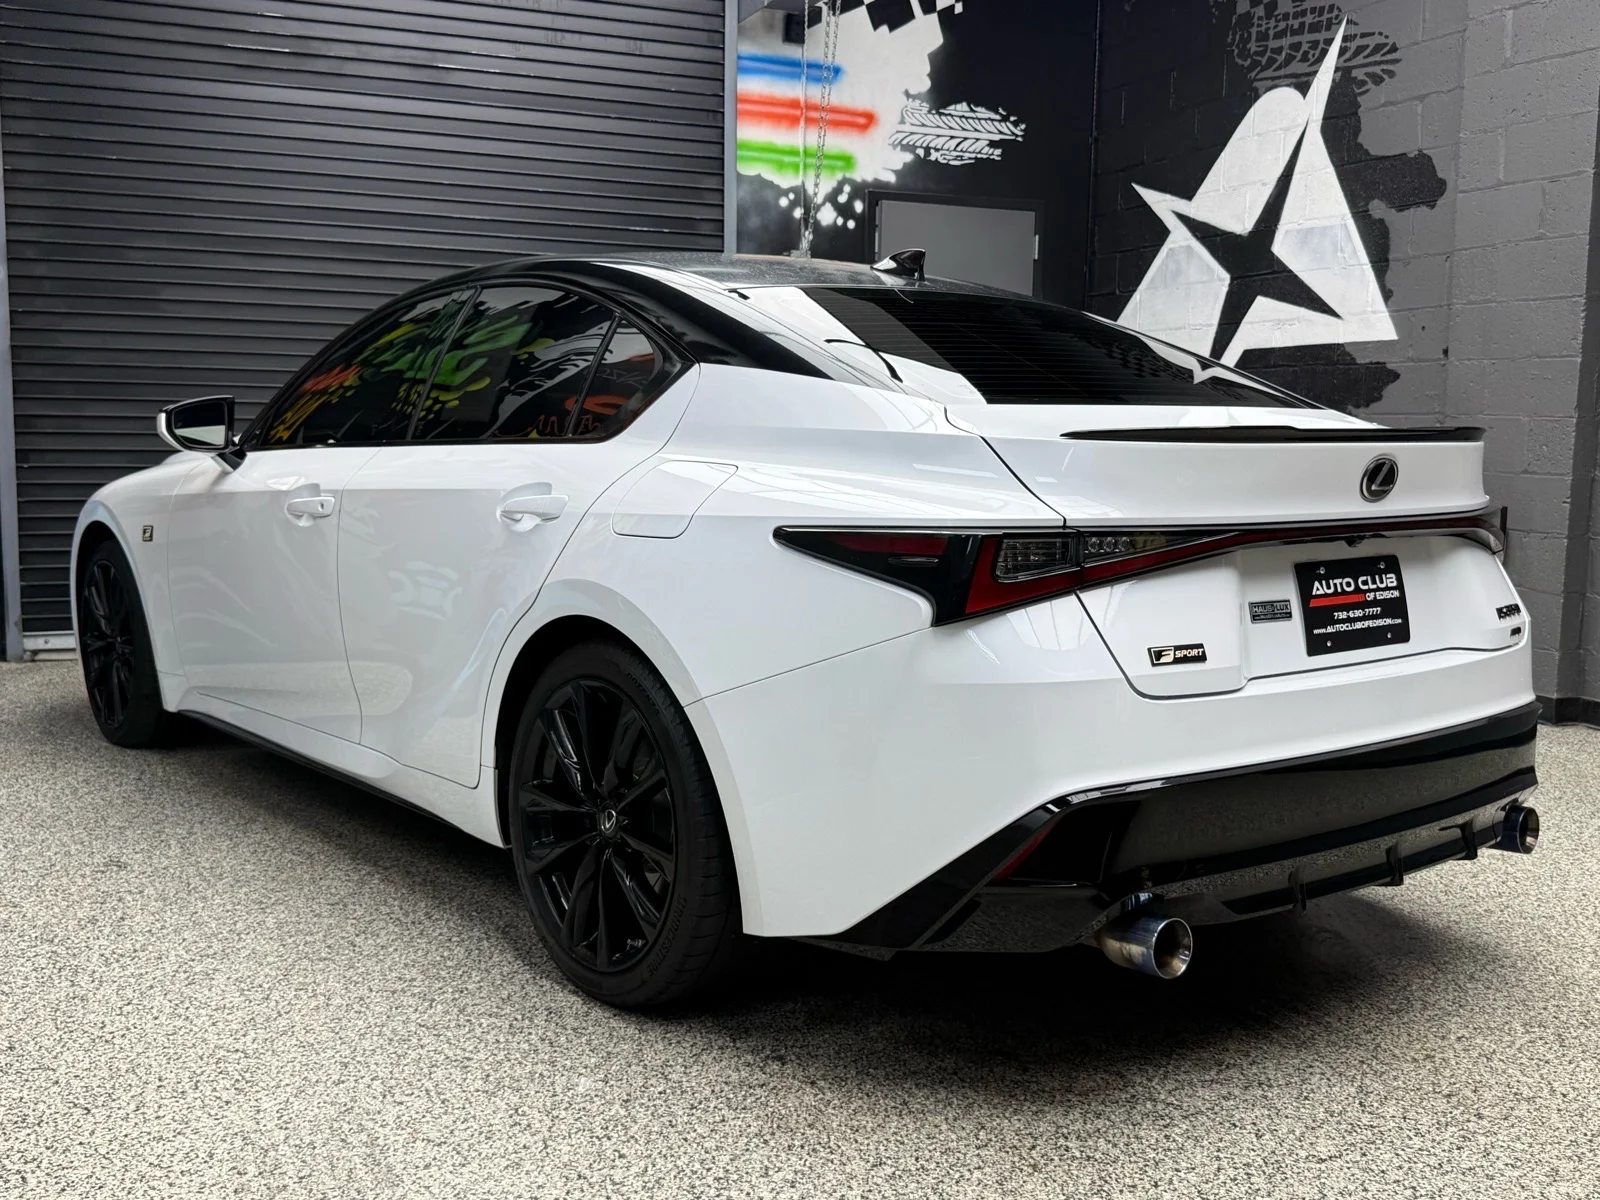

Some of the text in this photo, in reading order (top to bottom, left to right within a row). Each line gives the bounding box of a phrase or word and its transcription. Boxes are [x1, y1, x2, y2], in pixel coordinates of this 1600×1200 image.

[1312, 573, 1398, 595] AUTO CLUB
[1366, 590, 1399, 601] OF EDISON
[1252, 604, 1272, 613] HAUS
[1275, 603, 1290, 611] LUX
[1333, 607, 1381, 619] 732-630-7777
[1175, 648, 1204, 658] SPORT
